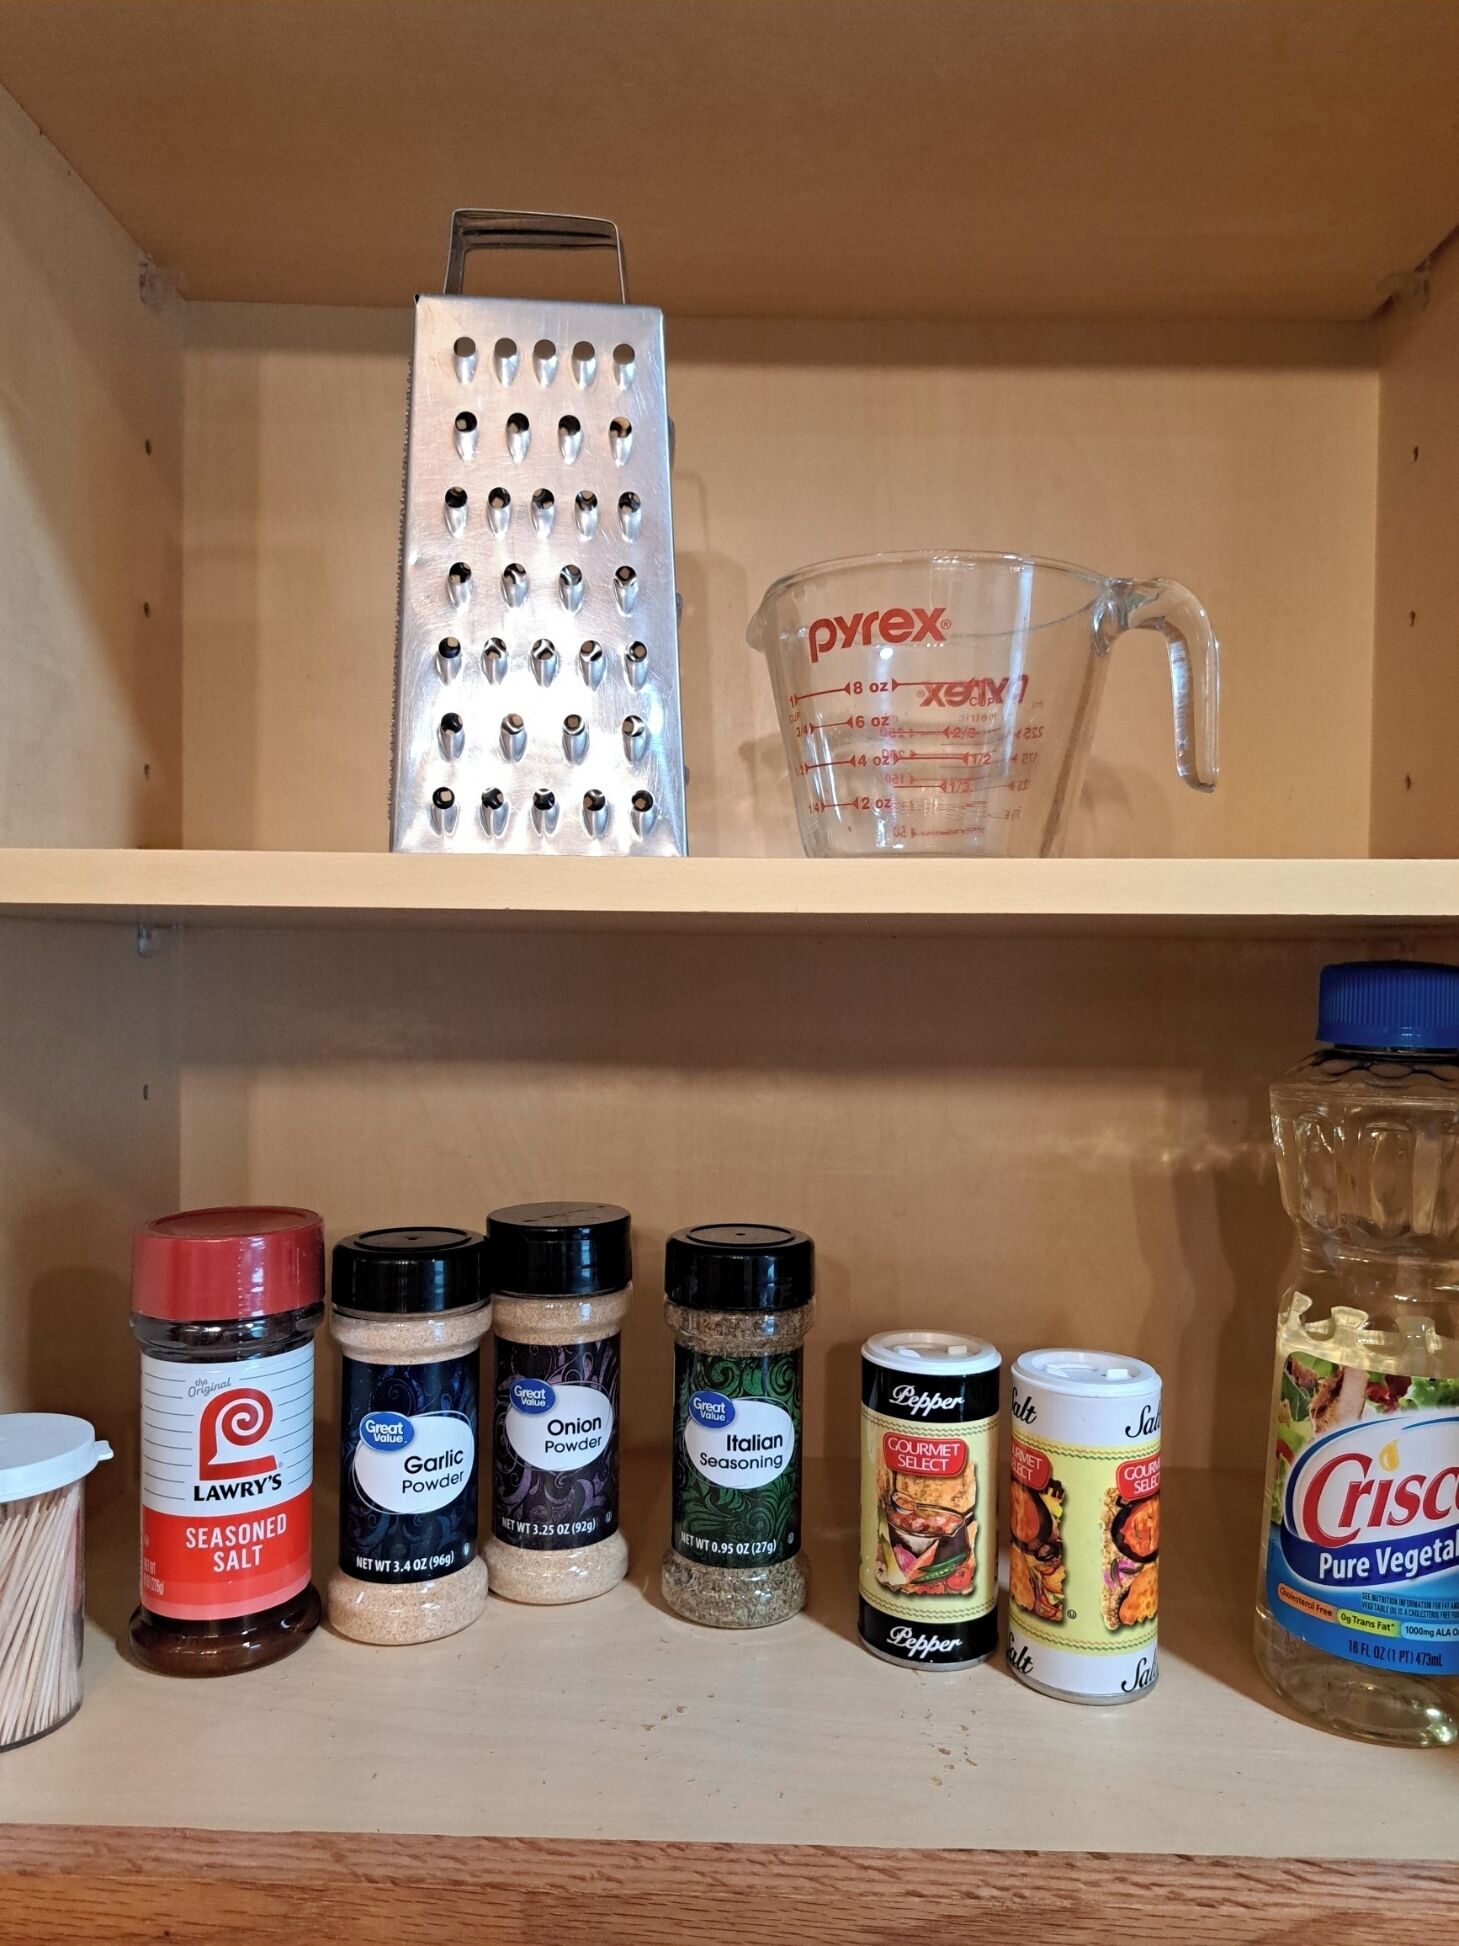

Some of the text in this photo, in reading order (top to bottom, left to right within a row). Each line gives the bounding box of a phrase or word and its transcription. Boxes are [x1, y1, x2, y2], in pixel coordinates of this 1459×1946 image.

[808, 607, 946, 663] pyrex
[853, 681, 889, 695] 8 oz
[968, 696, 995, 707] CUP
[855, 715, 865, 729] 6
[870, 716, 890, 727] oz
[858, 754, 890, 767] 4 oz
[971, 754, 992, 765] 1/2
[949, 782, 970, 793] 1/3
[861, 796, 870, 810] 2
[875, 798, 892, 809] oz
[188, 1377, 231, 1398] Original
[195, 1378, 208, 1387] the
[514, 1385, 546, 1401] Great
[520, 1396, 546, 1407] Value
[889, 1384, 965, 1416] Pepper
[693, 1397, 726, 1414] Great
[547, 1414, 602, 1436] Onion
[700, 1409, 726, 1422] Value
[1125, 1404, 1160, 1438] Sal
[366, 1419, 404, 1435] Great
[374, 1429, 404, 1444] Value
[545, 1435, 602, 1454] Powder
[726, 1433, 783, 1452] Italian
[887, 1438, 960, 1458] GOURMET
[404, 1449, 464, 1475] Garlic
[699, 1452, 783, 1470] Seasoning
[897, 1454, 949, 1472] SELECT
[194, 1473, 282, 1502] LAWRY'S
[402, 1470, 464, 1494] Powder
[1302, 1452, 1459, 1549] Crisc
[186, 1513, 287, 1548] SEASONED
[502, 1516, 596, 1535] NET WT 3.25 OZ (92g)
[680, 1532, 777, 1555] NET WT 0.95 OZ (27g)
[213, 1544, 264, 1573] SALT
[356, 1551, 455, 1572] NET WT 3.4 OZ (96g)
[1319, 1552, 1370, 1580] Pure
[1279, 1587, 1333, 1617] Cholesterol Free
[1340, 1612, 1352, 1624] 0g
[1351, 1614, 1375, 1629] Trans
[1404, 1625, 1435, 1638] 1000mg
[1435, 1628, 1451, 1637] ALA
[886, 1626, 963, 1659] Pepper
[1348, 1639, 1443, 1668] 16 FL OZ (1 PT) 473mL
